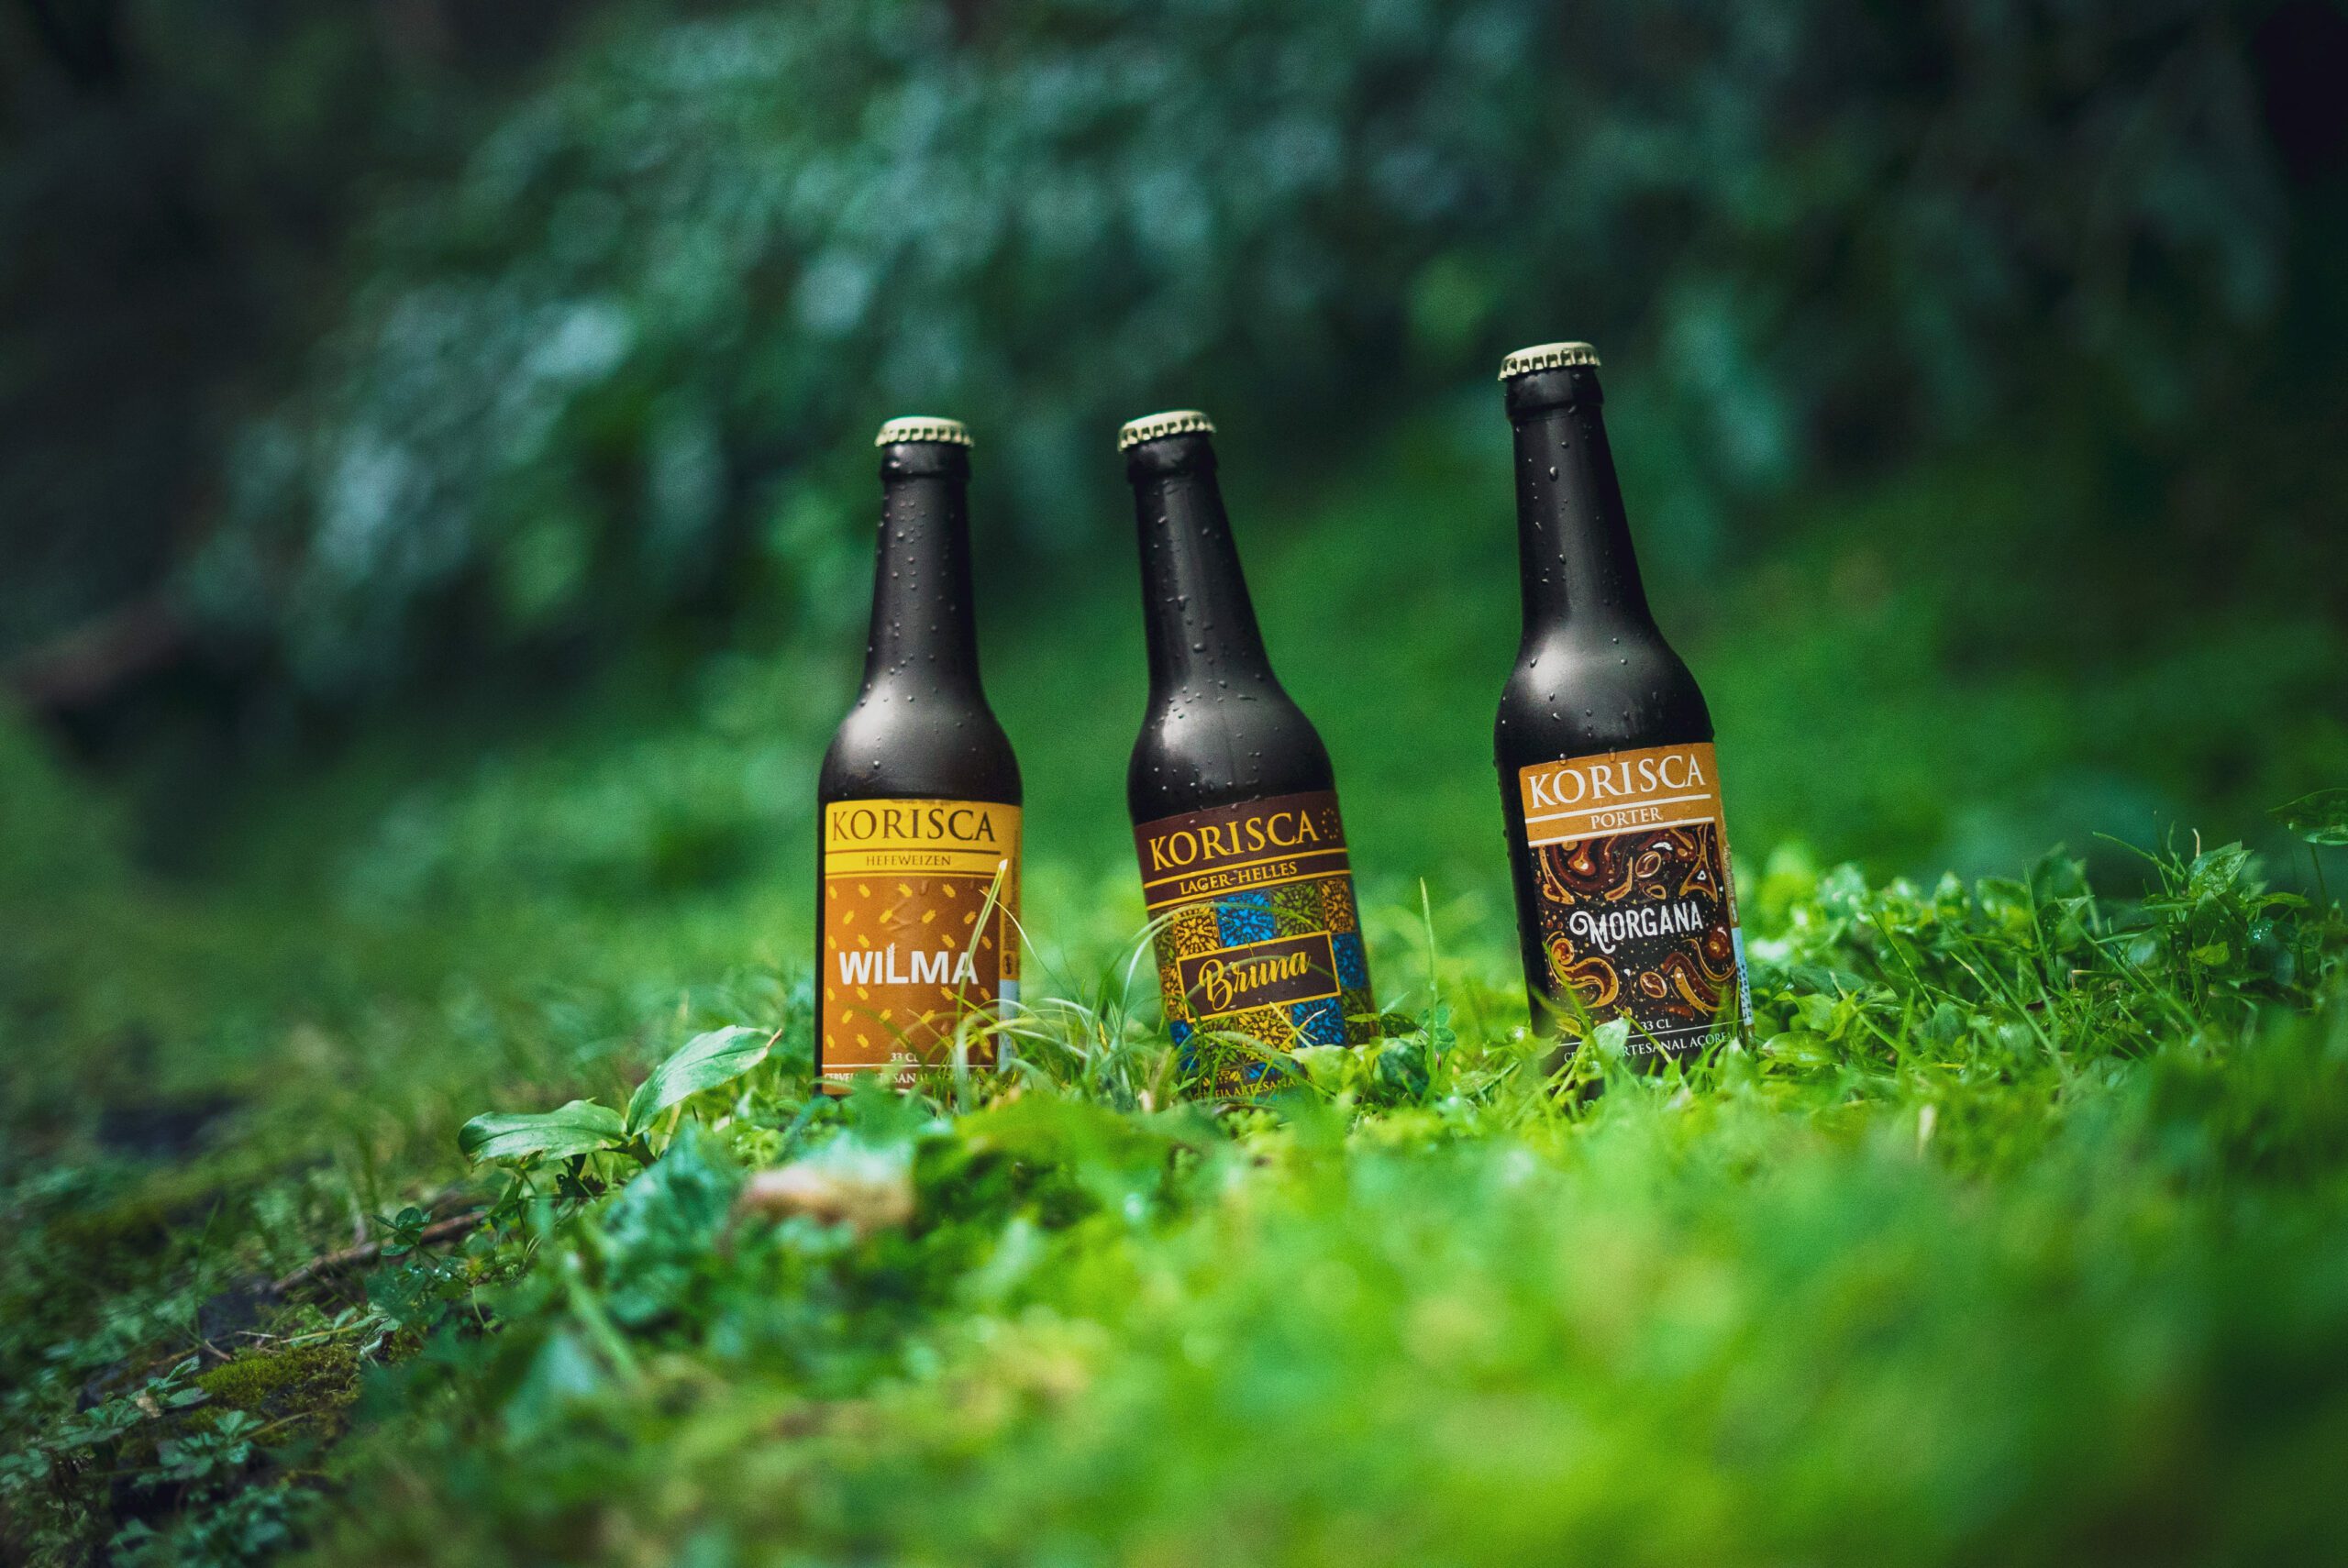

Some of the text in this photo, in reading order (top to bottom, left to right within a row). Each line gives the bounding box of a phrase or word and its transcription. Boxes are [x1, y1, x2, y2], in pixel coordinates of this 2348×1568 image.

[1527, 753, 1707, 809] KORISCA
[832, 808, 996, 842] KORISCA
[1589, 806, 1664, 830] PORTER
[1148, 809, 1320, 872] KORISCA
[866, 855, 951, 867] HEFEWEIZEN
[1179, 860, 1298, 896] LAGER-HELLES
[1568, 900, 1704, 955] MORGANA
[838, 943, 980, 985] WILMA
[1197, 951, 1312, 1011] Bruna
[1656, 1019, 1672, 1029] CL
[1621, 1038, 1688, 1058] RTESANAL
